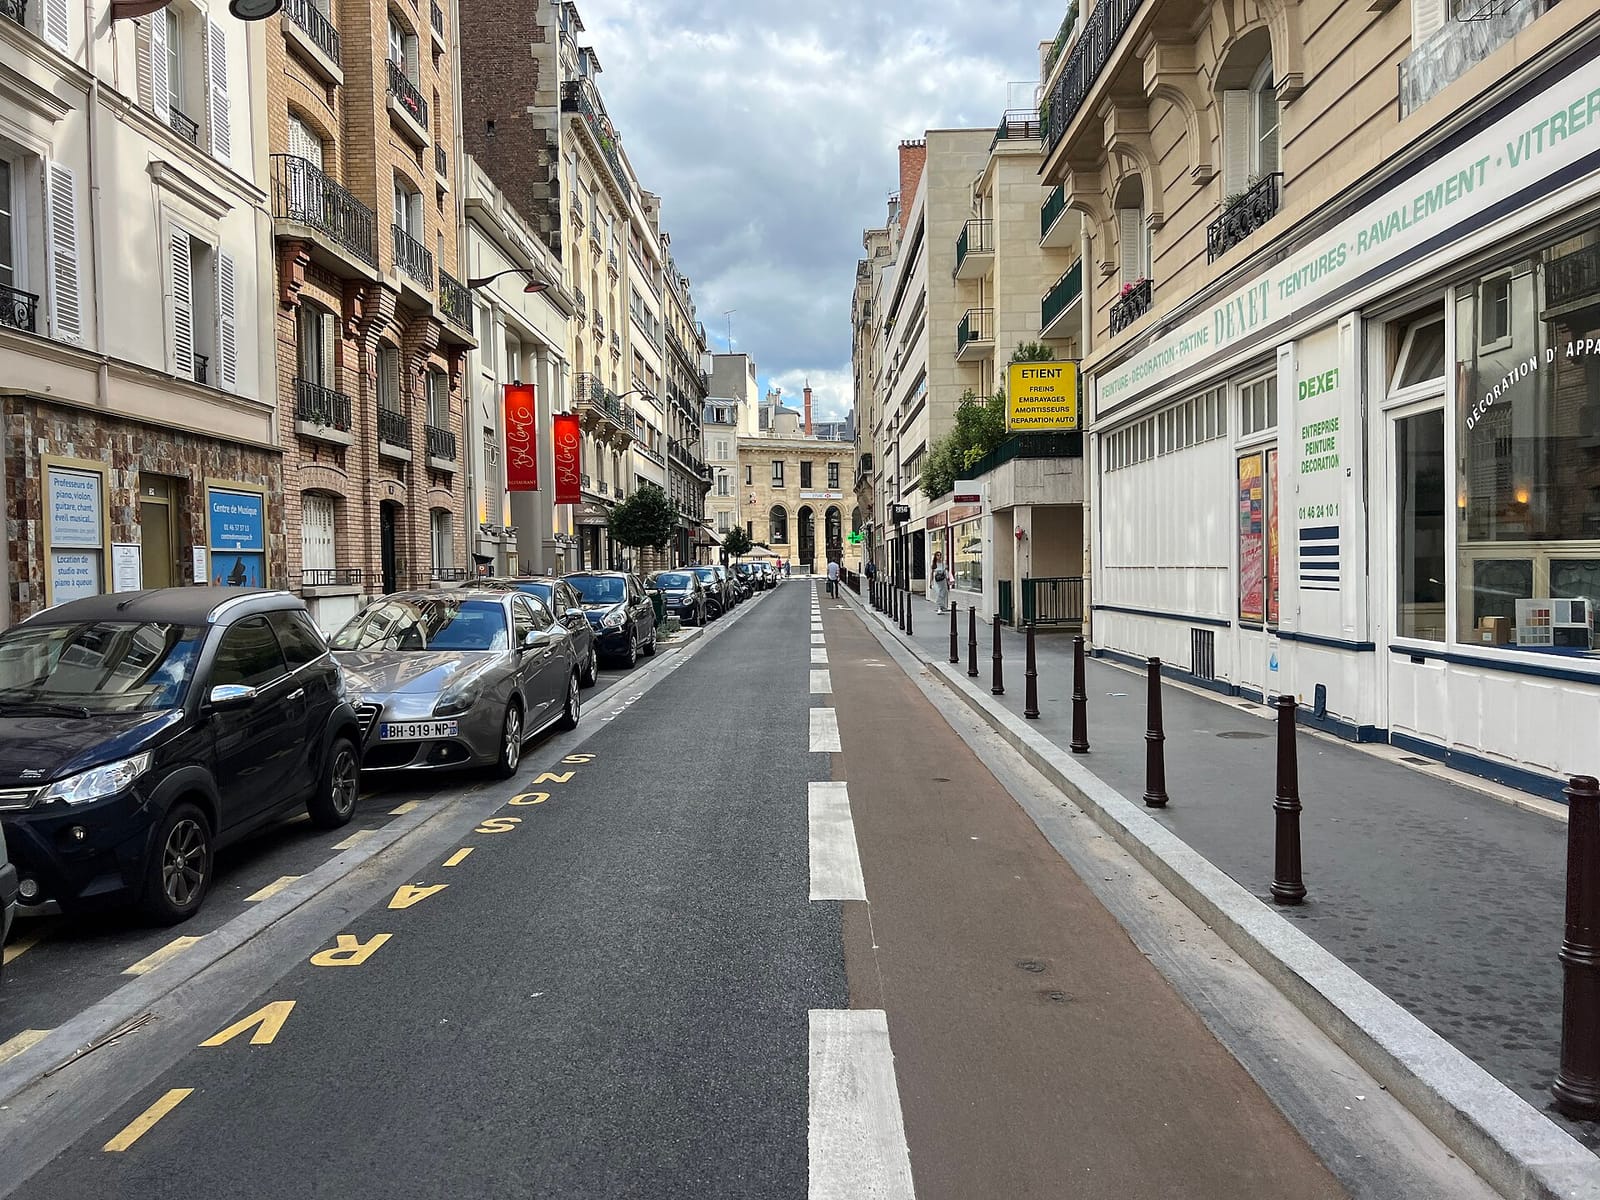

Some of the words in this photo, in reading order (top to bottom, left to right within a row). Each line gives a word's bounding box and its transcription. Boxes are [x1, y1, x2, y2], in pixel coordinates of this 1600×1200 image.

[1101, 374, 1129, 399] PEINTURE
[1179, 326, 1209, 357] PATINE
[1213, 279, 1270, 345] DEXET
[1278, 242, 1347, 300] TENTURES
[1357, 155, 1491, 256] RAVALEMENT
[1021, 368, 1062, 379] ETIENT
[1029, 385, 1055, 393] FREINS
[1466, 356, 1538, 430] DÉCORATION
[1018, 395, 1066, 403] EMBRAYAGES
[1014, 406, 1070, 414] AMORTISSEURS
[507, 406, 534, 442] Canto
[1301, 417, 1339, 440] ENTREPRISE
[1305, 436, 1335, 456] PEINTURE
[508, 442, 534, 469] Bel
[1301, 454, 1339, 474] DECORATION
[54, 478, 86, 489] Professeurs
[87, 482, 94, 490] de
[213, 503, 230, 514] Centre
[231, 505, 237, 514] de
[238, 506, 257, 517] Musique
[1299, 507, 1305, 519] 01
[1317, 505, 1323, 518] 24
[1326, 504, 1333, 517] 10
[57, 556, 79, 564] Location
[80, 556, 88, 564] de
[58, 567, 75, 575] studio
[389, 723, 449, 737] BH-919-NP
